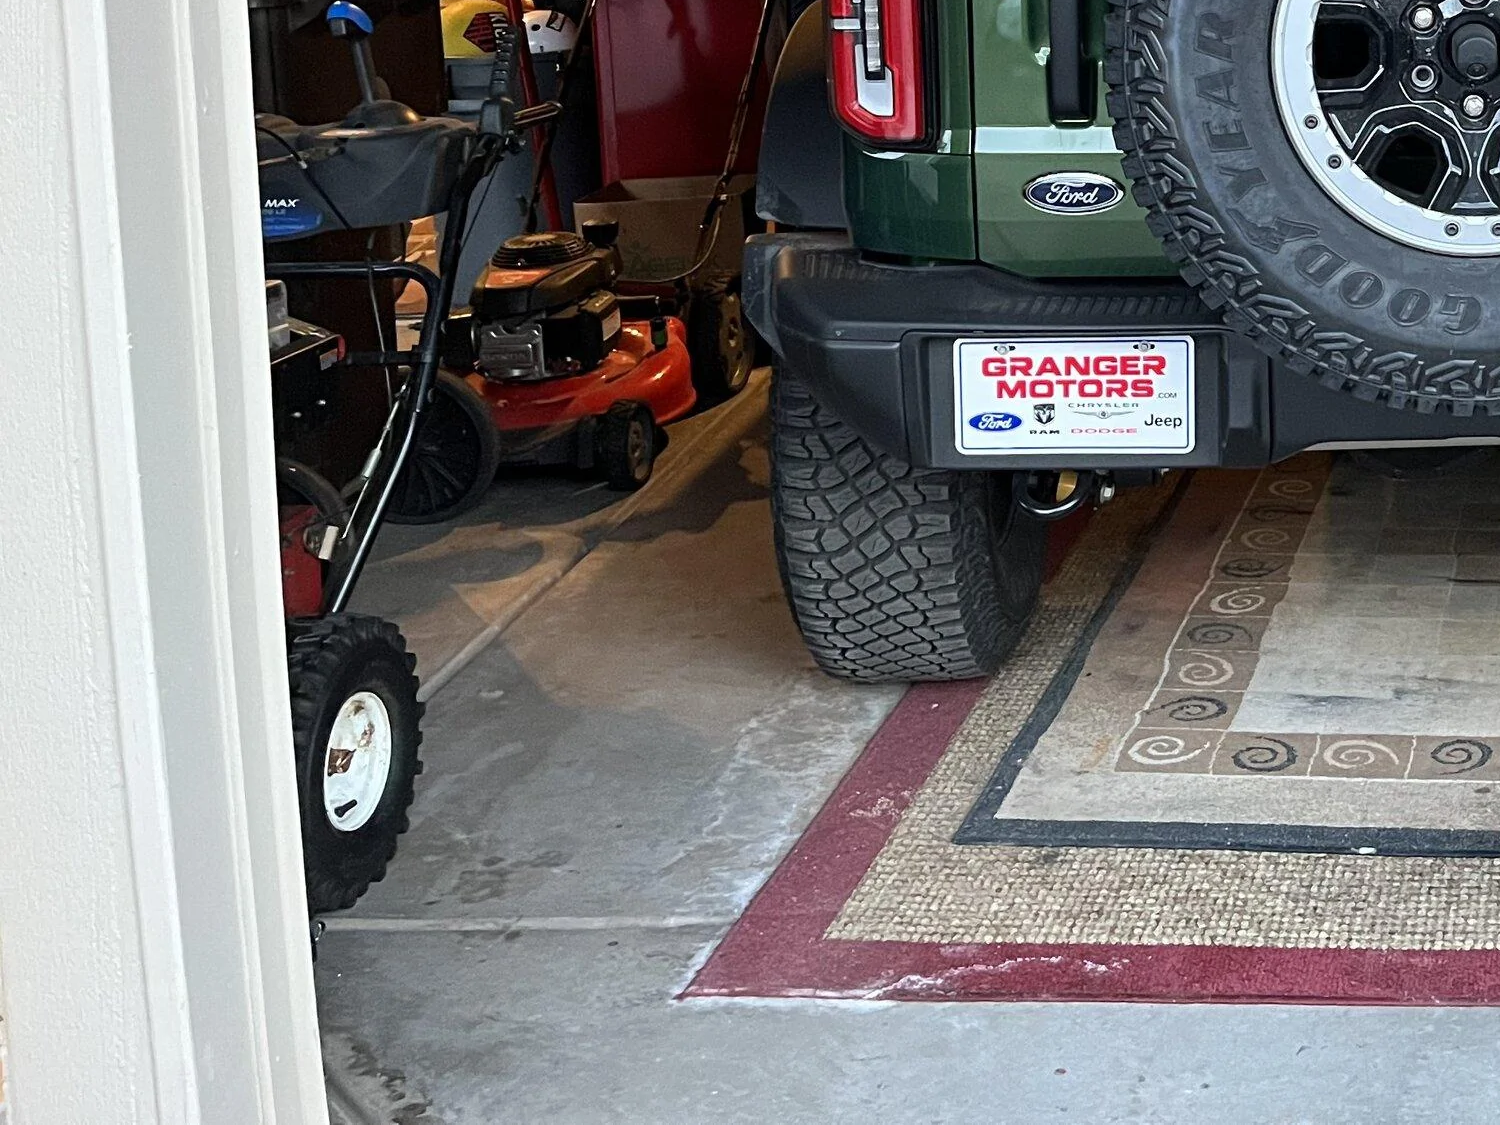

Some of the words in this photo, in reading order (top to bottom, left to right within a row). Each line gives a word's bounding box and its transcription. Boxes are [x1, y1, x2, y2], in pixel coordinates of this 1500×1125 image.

[1045, 179, 1100, 204] Ford
[264, 198, 300, 208] MAX
[981, 355, 1167, 377] GRANGER
[996, 378, 1155, 399] MOTORS
[978, 414, 1013, 430] Ford
[1144, 413, 1183, 429] Jeep
